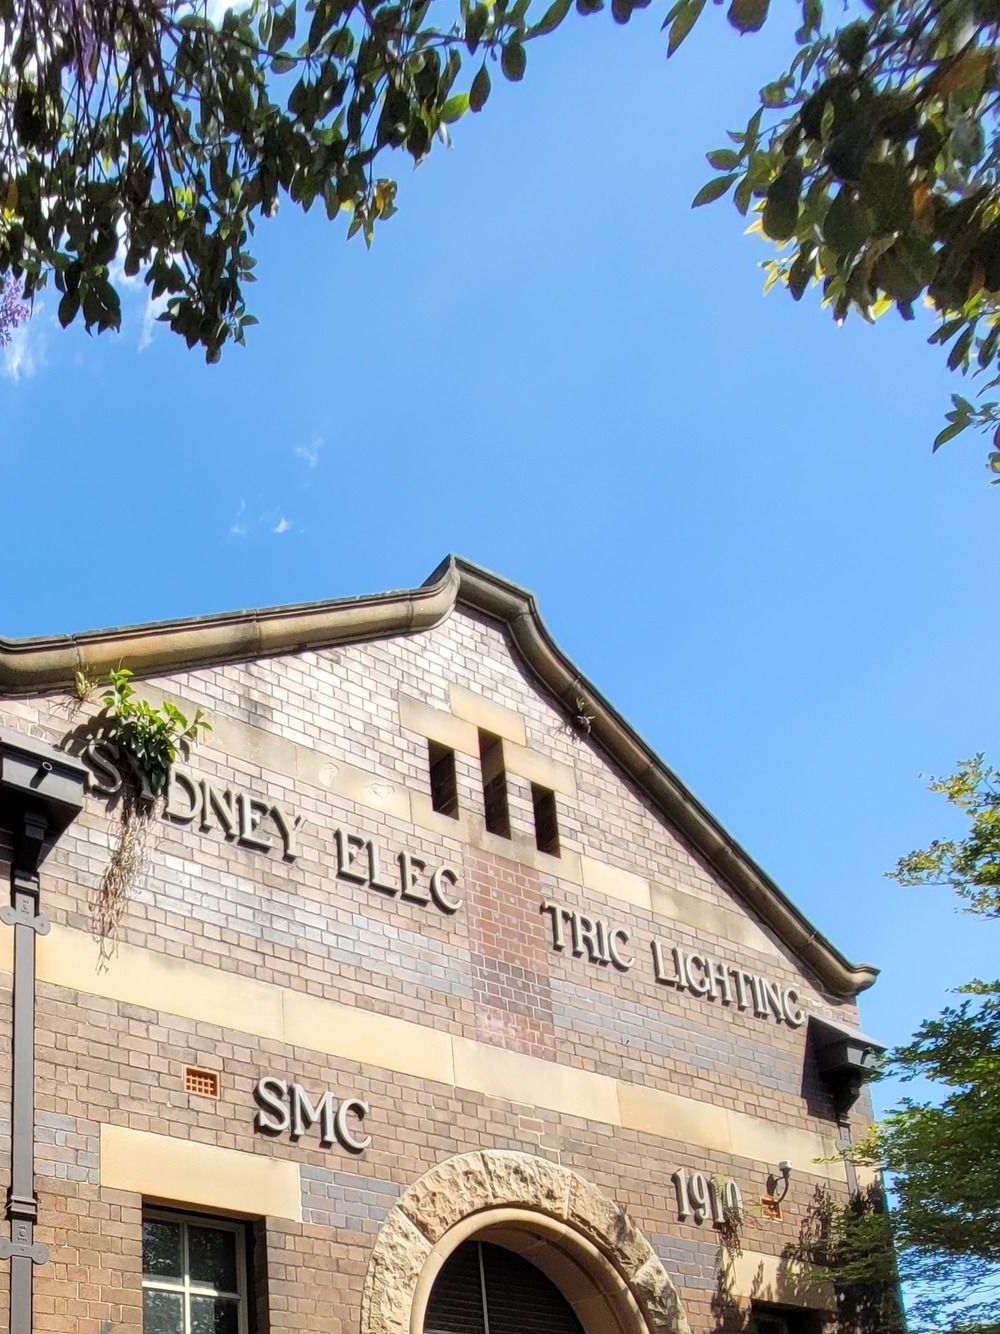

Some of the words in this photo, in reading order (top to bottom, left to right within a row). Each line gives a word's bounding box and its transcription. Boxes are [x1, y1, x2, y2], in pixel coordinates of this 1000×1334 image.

[334, 829, 464, 913] ELEC
[541, 901, 635, 970] TRIC
[652, 939, 804, 1026] LIGHTING
[256, 1075, 372, 1151] SMC
